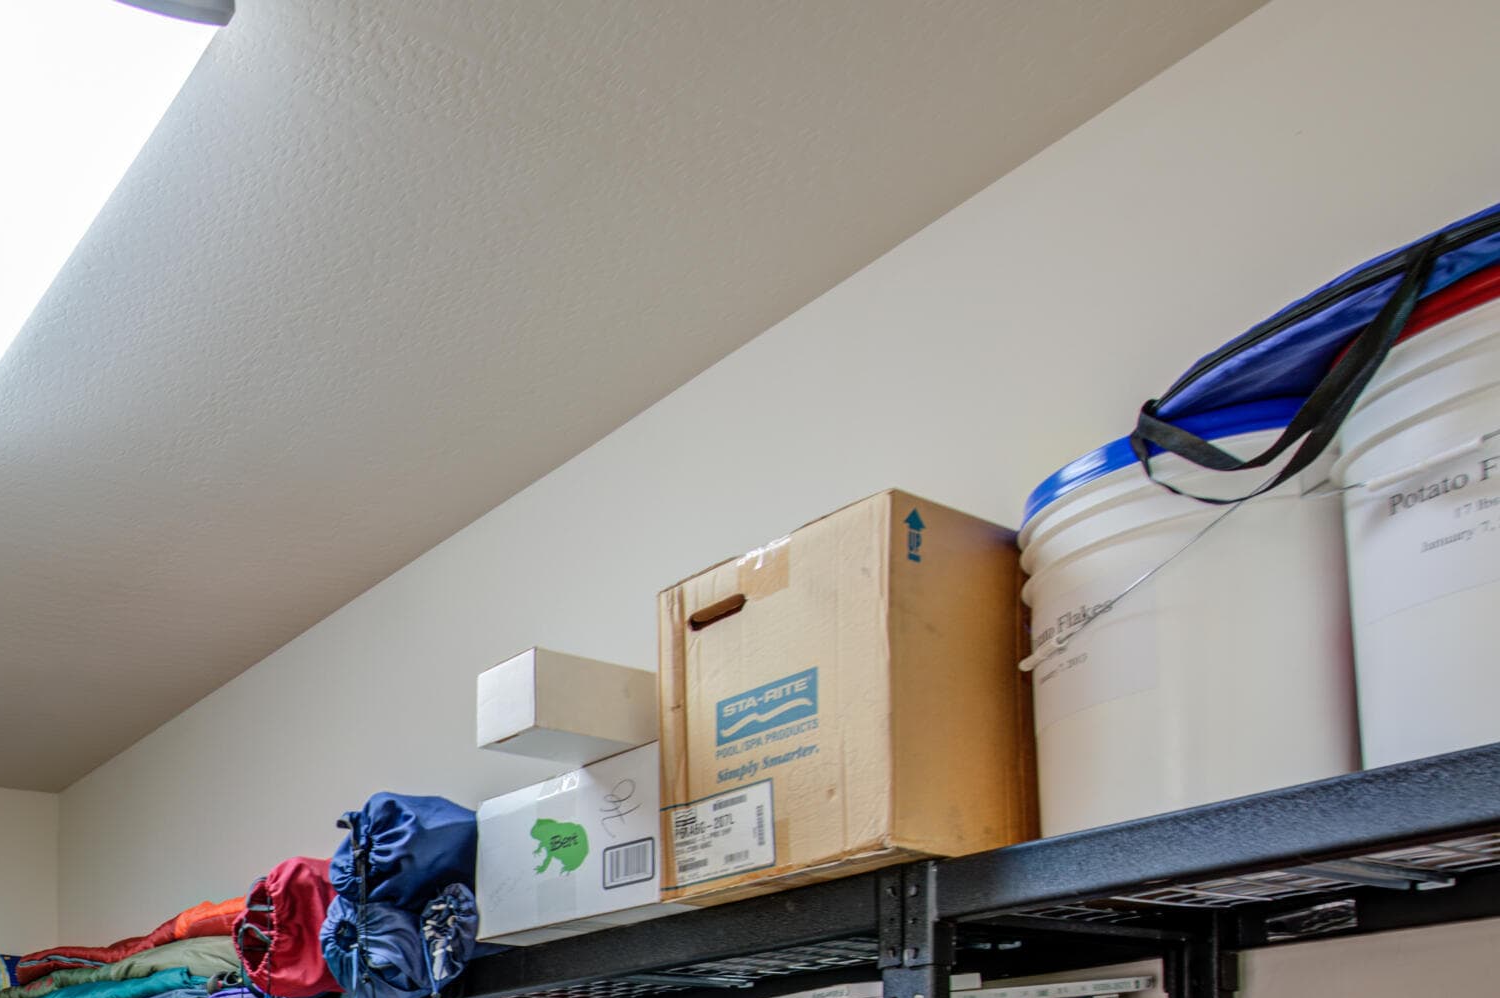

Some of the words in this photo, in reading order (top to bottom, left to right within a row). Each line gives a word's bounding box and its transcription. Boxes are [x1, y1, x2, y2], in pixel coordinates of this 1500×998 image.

[1388, 473, 1469, 517] Potato
[722, 676, 809, 718] STA-RITE
[717, 760, 759, 784] Simply
